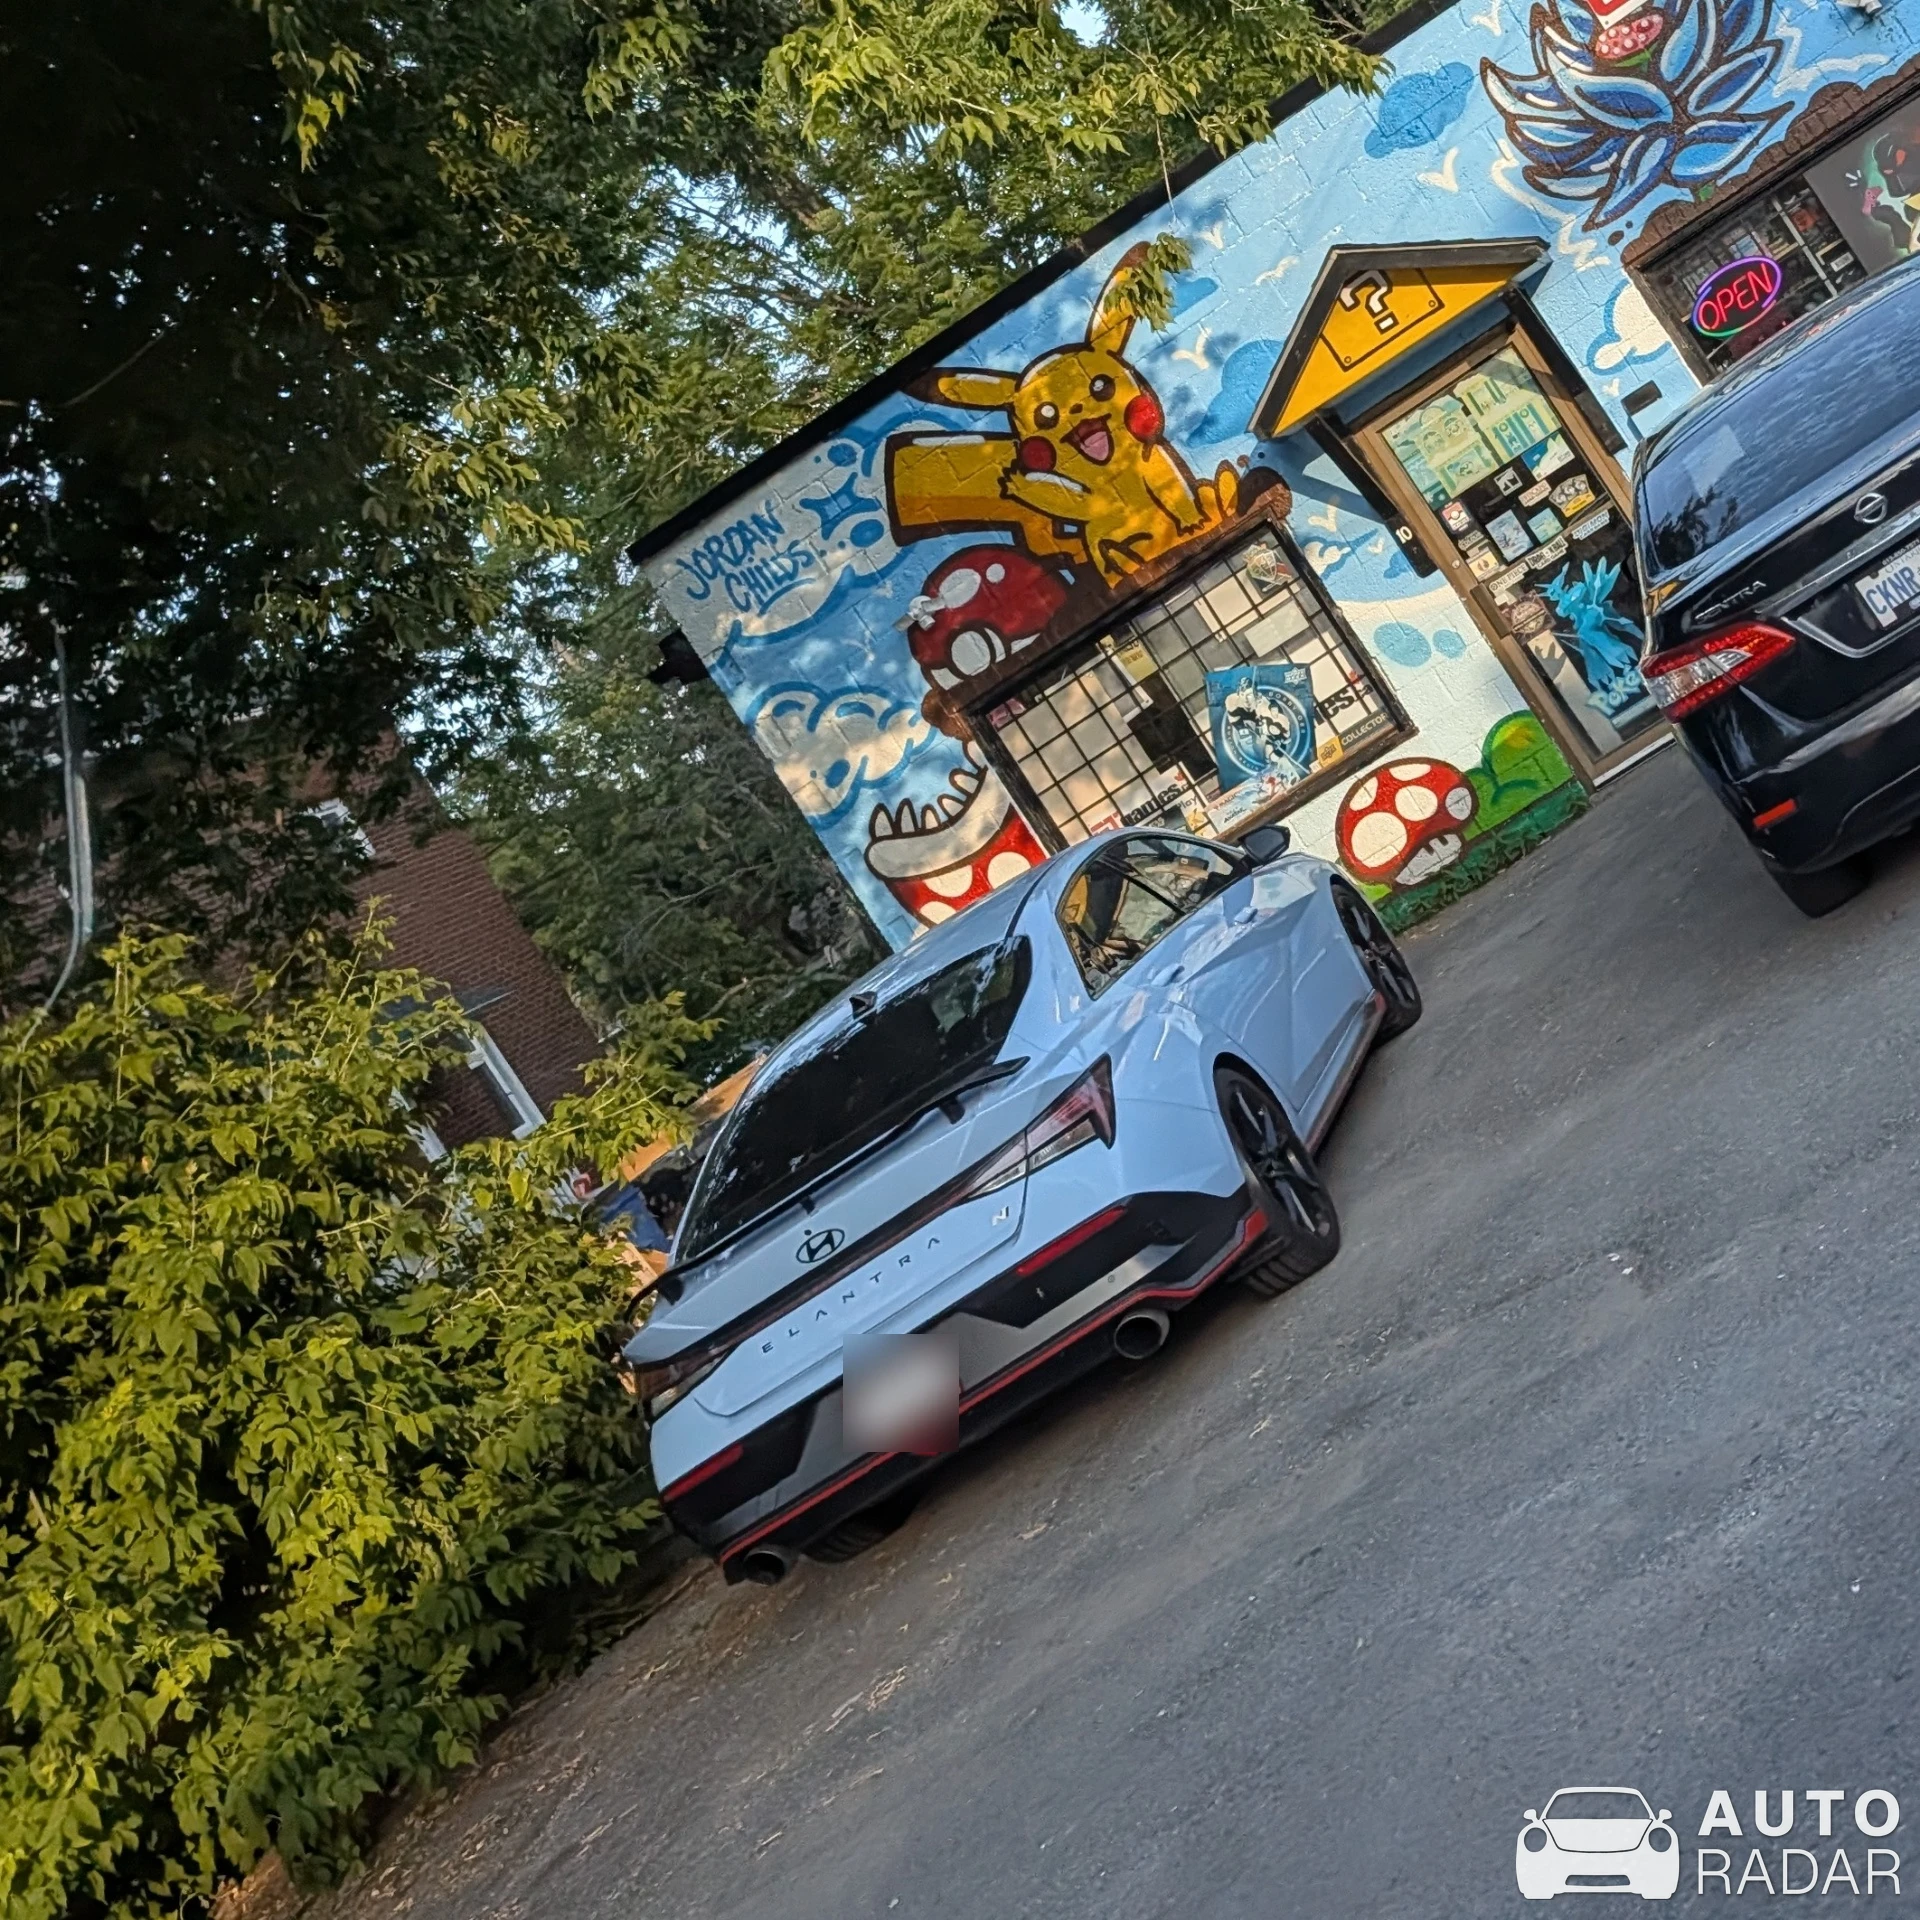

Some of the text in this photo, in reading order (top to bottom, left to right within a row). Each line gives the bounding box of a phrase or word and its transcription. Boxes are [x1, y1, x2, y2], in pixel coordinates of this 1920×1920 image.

[1699, 262, 1773, 330] OPEN
[676, 500, 786, 600] JORDAN
[1395, 525, 1413, 544] 10
[1695, 581, 1767, 624] SENTRA
[1866, 566, 1920, 615] CKNR
[762, 1238, 940, 1353] ELANTRA
